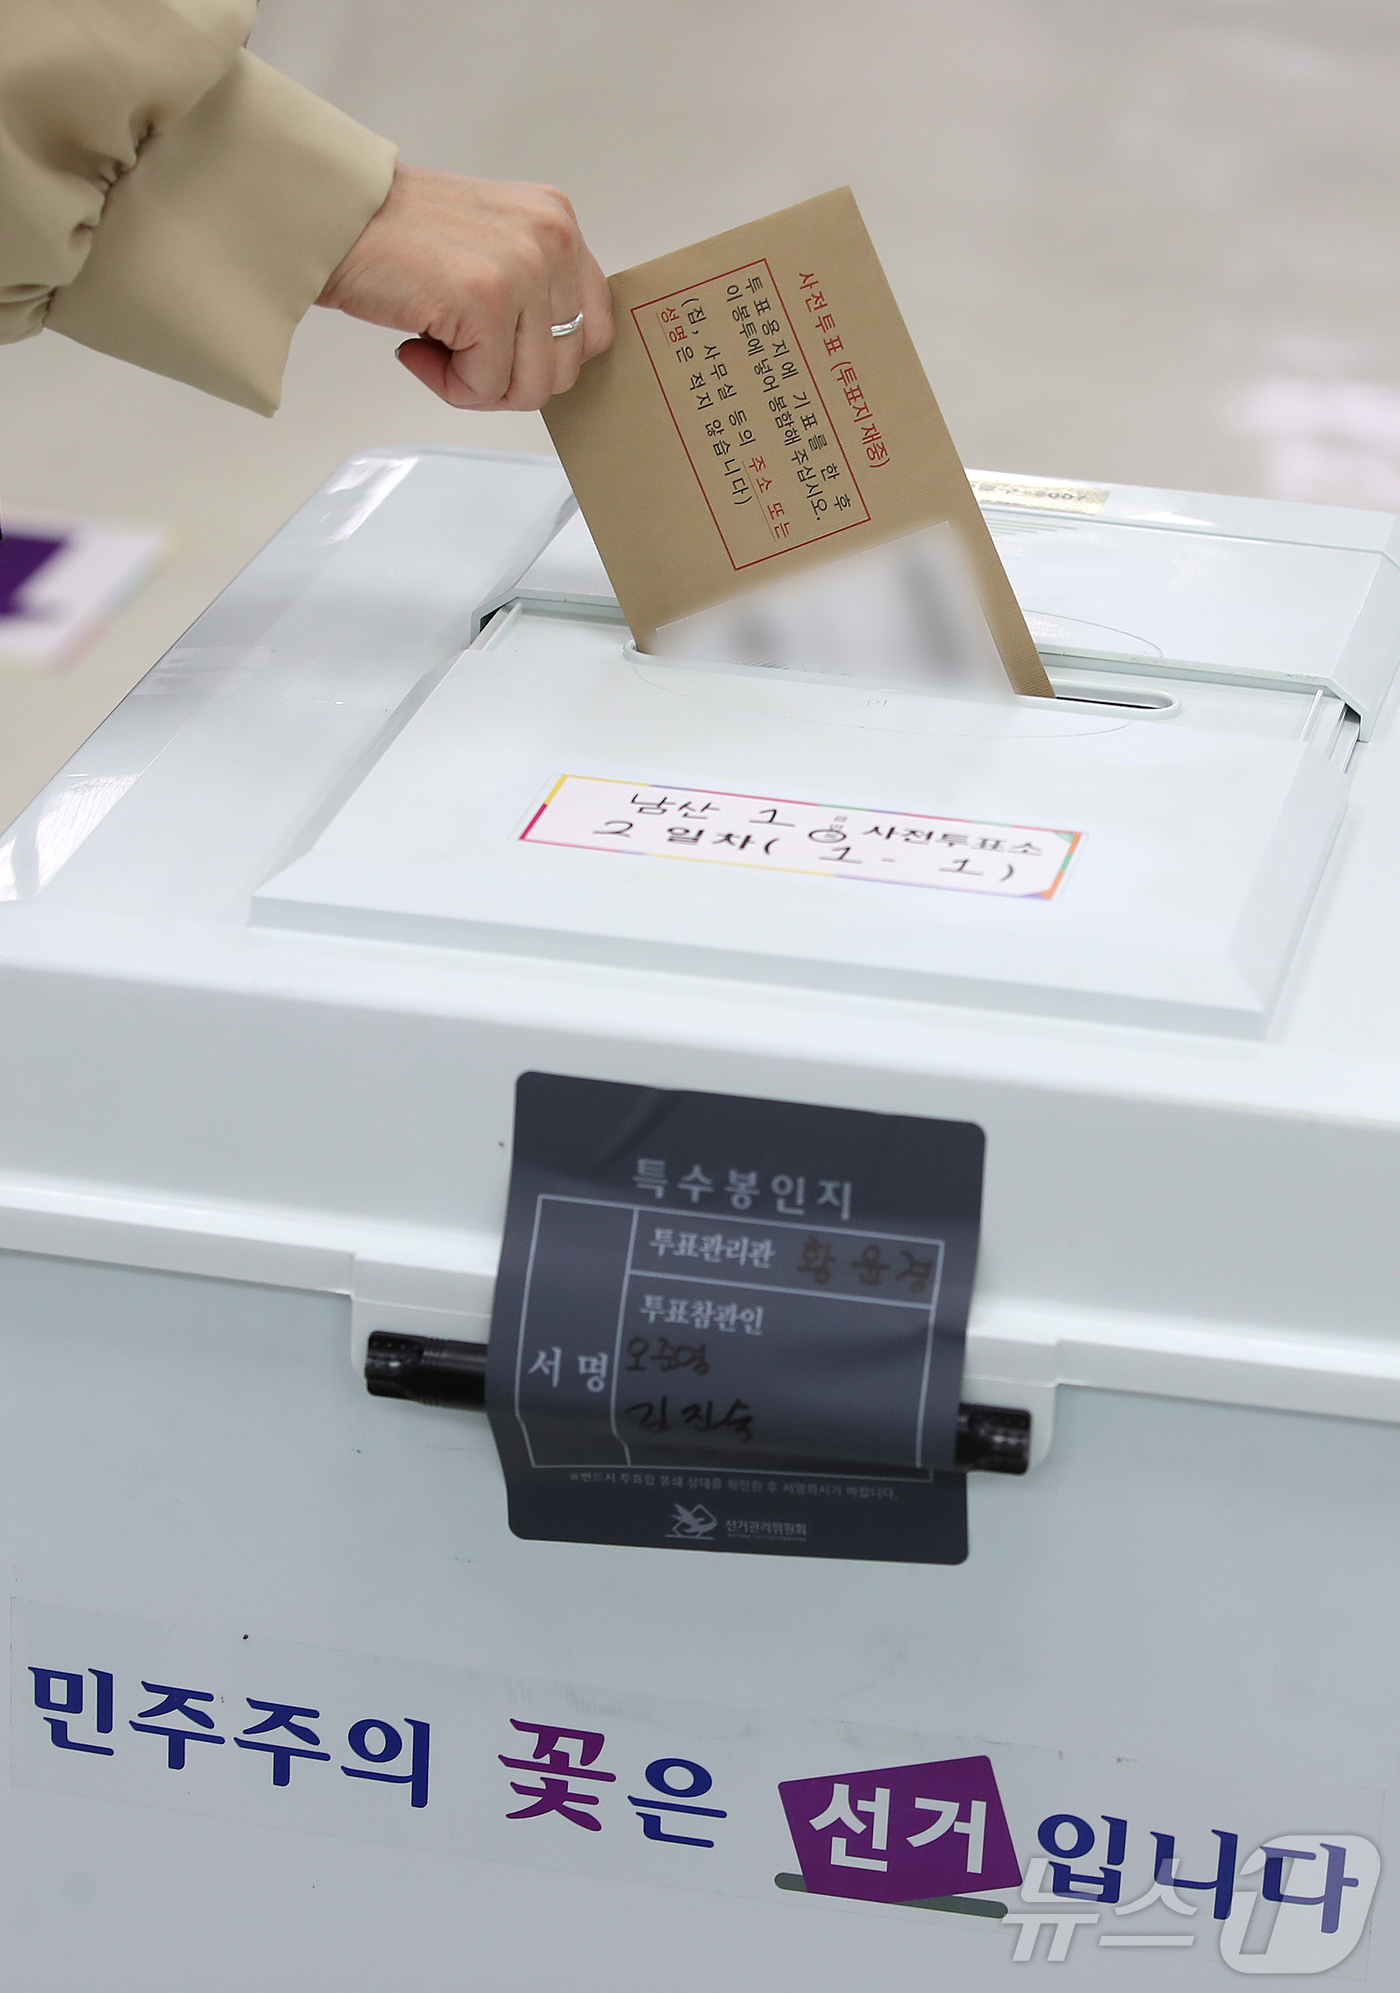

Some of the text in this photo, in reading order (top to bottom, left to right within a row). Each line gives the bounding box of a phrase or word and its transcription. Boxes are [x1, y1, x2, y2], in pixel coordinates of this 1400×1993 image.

[799, 273, 844, 356] 사전투표
[661, 307, 752, 504] 성명은 적지 않습니다)
[681, 298, 790, 539] (집, 사무실 등의 주소 또는
[726, 285, 828, 521] 이 봉투에 넣어 봉함해 주십시오.
[744, 276, 851, 511] 투표용지에 기표를 한 후
[592, 821, 636, 838] 2
[819, 847, 864, 864] 1
[939, 859, 983, 875] 1
[630, 793, 720, 820] 남산
[749, 808, 796, 827] 1
[862, 825, 1044, 857] 사전투표소
[632, 1158, 853, 1219] 특수봉인지
[648, 1228, 776, 1269] 투표관리관
[640, 1294, 764, 1336] 투표참관인
[27, 1665, 431, 1810] 민주주의
[497, 1717, 729, 1849] 꽃은
